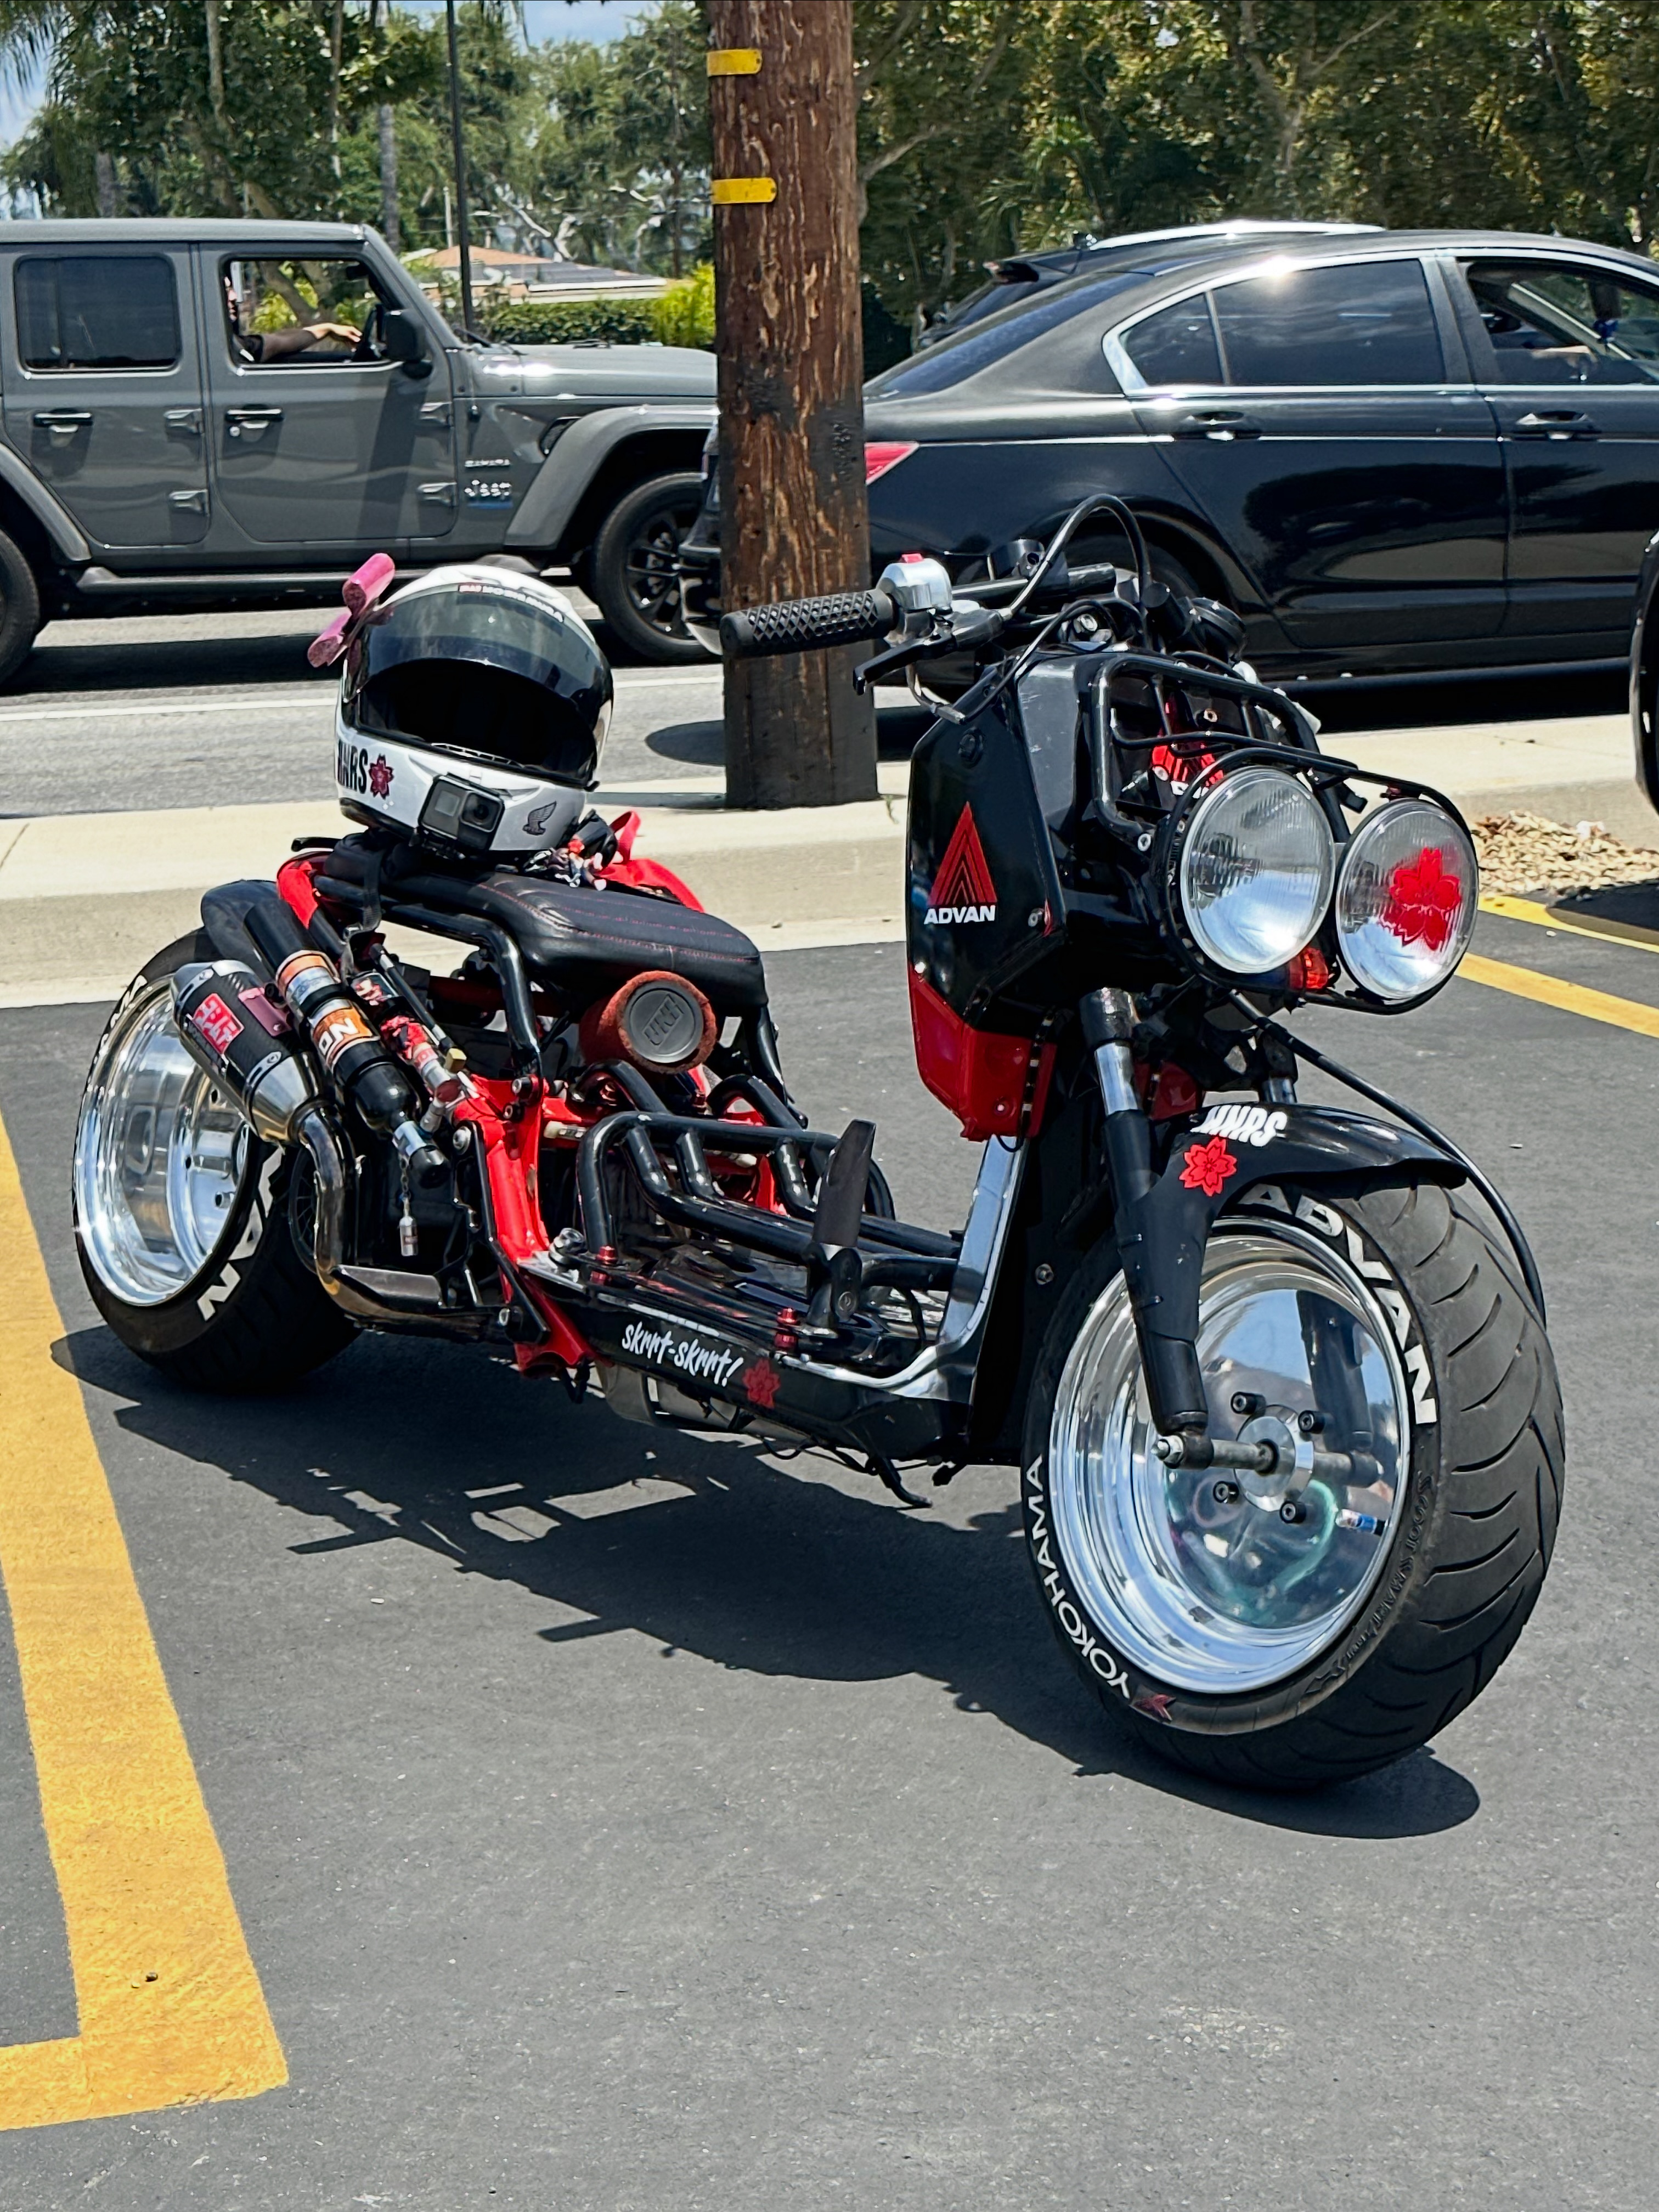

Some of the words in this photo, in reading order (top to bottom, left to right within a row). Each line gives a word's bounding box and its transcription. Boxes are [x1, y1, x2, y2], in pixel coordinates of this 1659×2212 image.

[923, 905, 996, 925] ADVAN
[1238, 1183, 1437, 1425] ADVAN
[1026, 1455, 1130, 1700] YOKOHAMA
